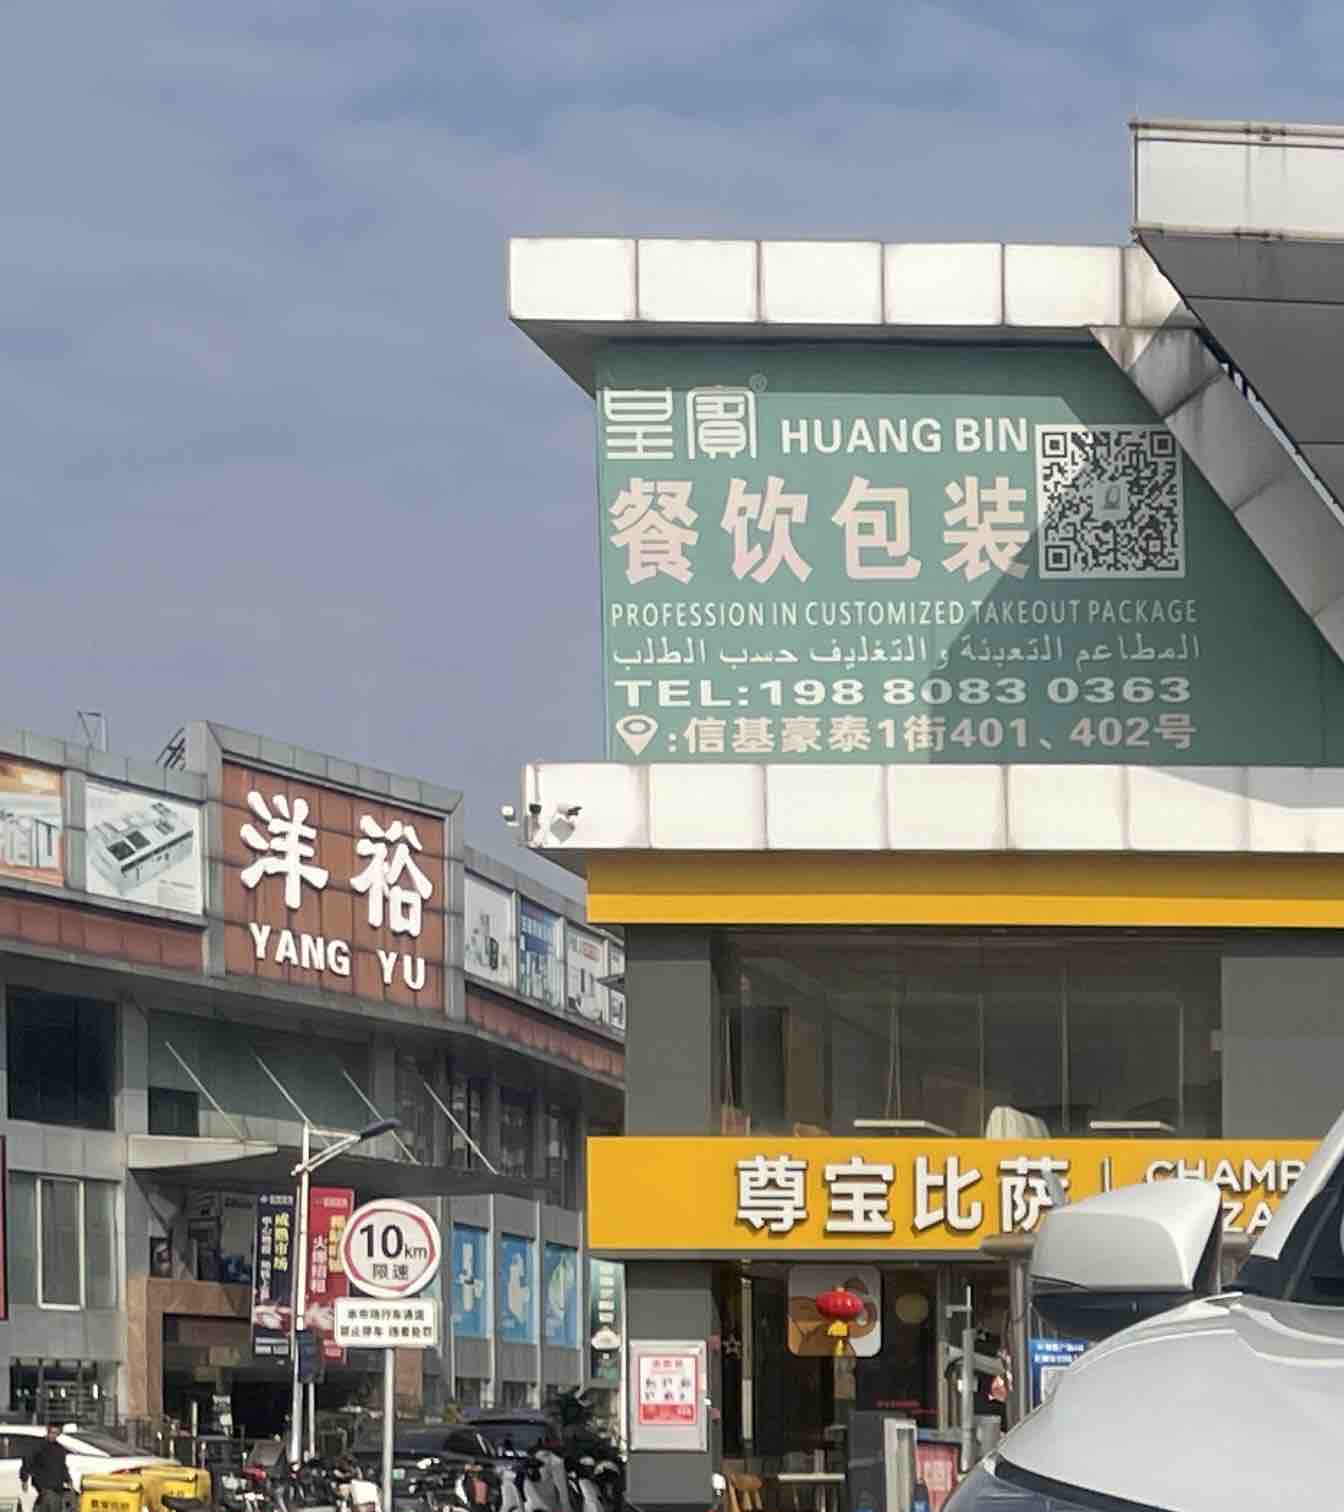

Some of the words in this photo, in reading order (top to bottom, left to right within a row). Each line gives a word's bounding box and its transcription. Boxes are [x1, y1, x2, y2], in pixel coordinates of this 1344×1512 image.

[781, 418, 942, 455] HUANG
[954, 416, 1028, 453] BIN
[609, 475, 1030, 584] 餐饮包装
[611, 602, 770, 628] PROFESSION
[772, 602, 798, 627] IN
[805, 601, 964, 626] CUSTOMIZED
[971, 600, 1080, 625] TAKEOUT
[1088, 598, 1199, 625] PACKAGE
[613, 678, 865, 707] TEL:198
[883, 677, 1027, 705] 8083
[1047, 676, 1191, 704] 0363
[240, 791, 433, 937] 洋裕
[249, 922, 351, 977] YANG
[376, 950, 426, 991] YU
[736, 1154, 1070, 1234] 尊宝比萨
[372, 1262, 409, 1281] 限速
